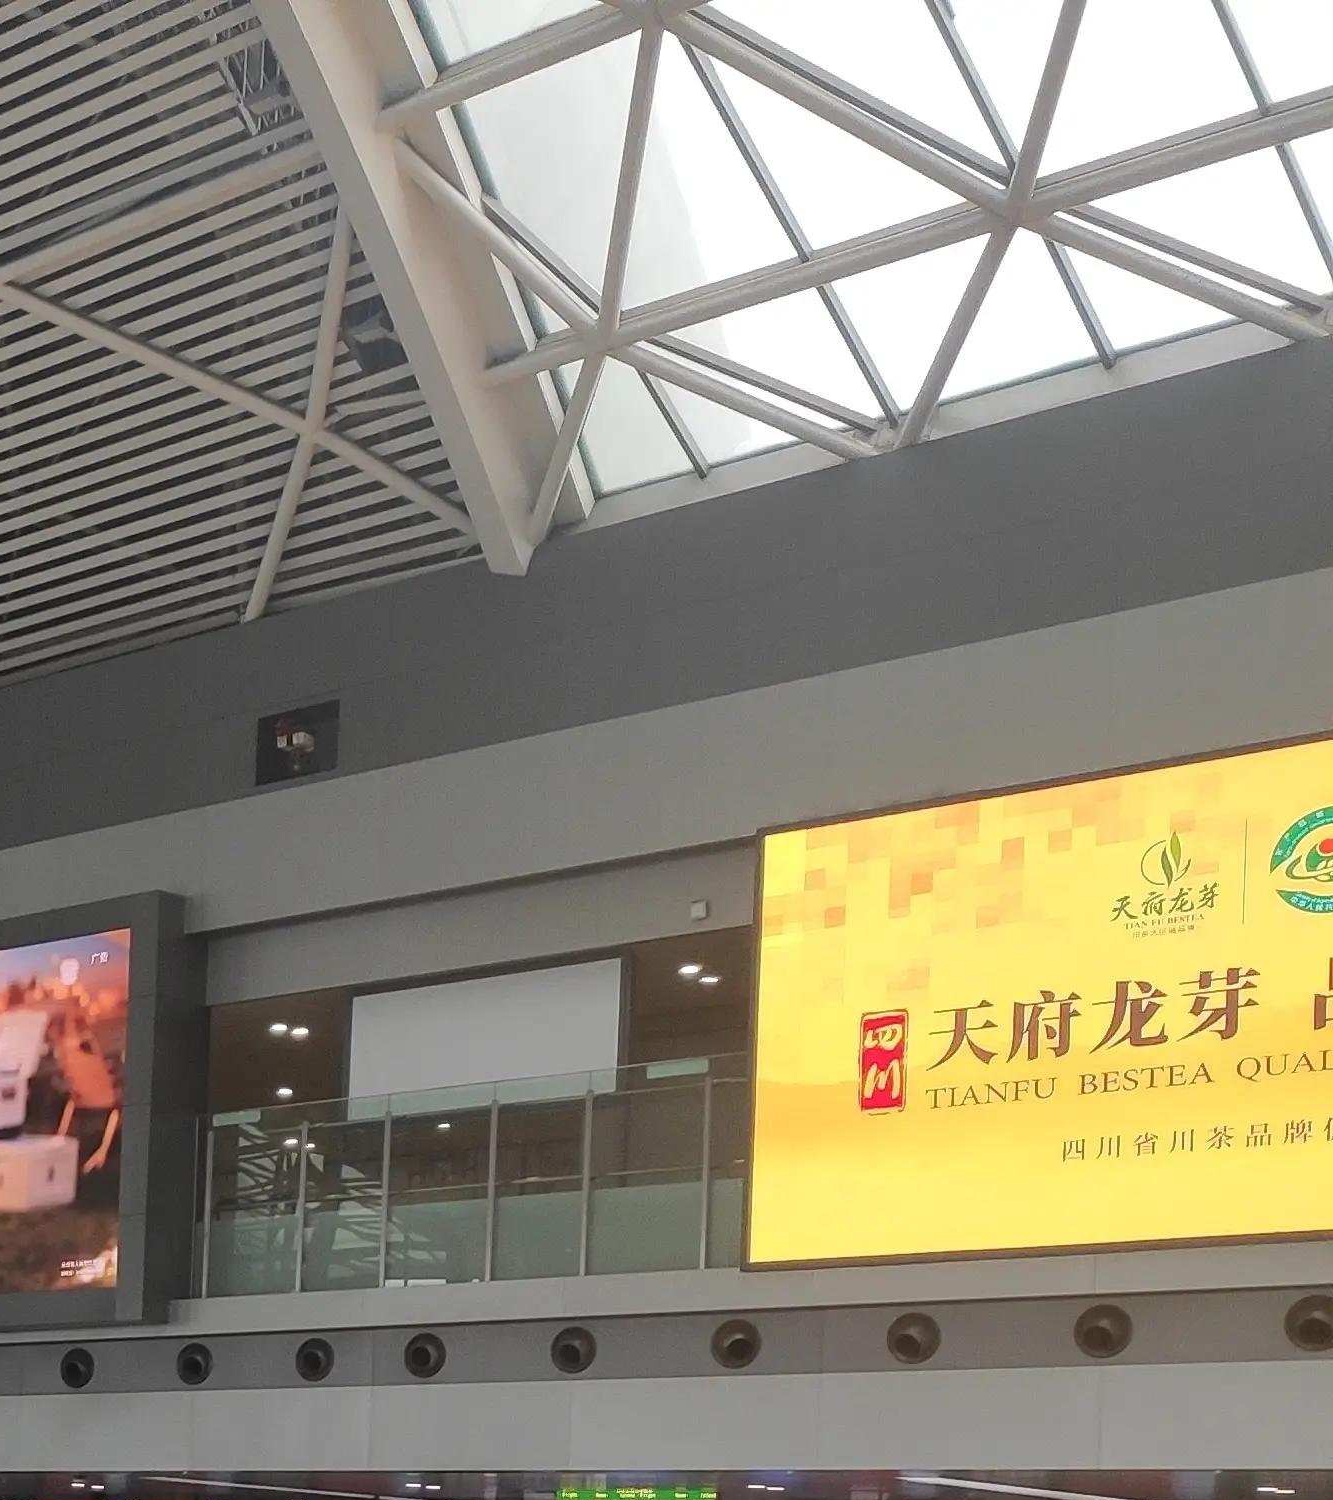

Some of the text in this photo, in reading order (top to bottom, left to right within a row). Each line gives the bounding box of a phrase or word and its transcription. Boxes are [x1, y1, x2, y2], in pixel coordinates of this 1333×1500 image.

[1110, 881, 1219, 922] 天府龙芽
[926, 967, 1261, 1071] 天府龙芽
[864, 1022, 904, 1101] 四川
[926, 1076, 1058, 1110] TIANFU
[1077, 1062, 1213, 1097] BESTEA
